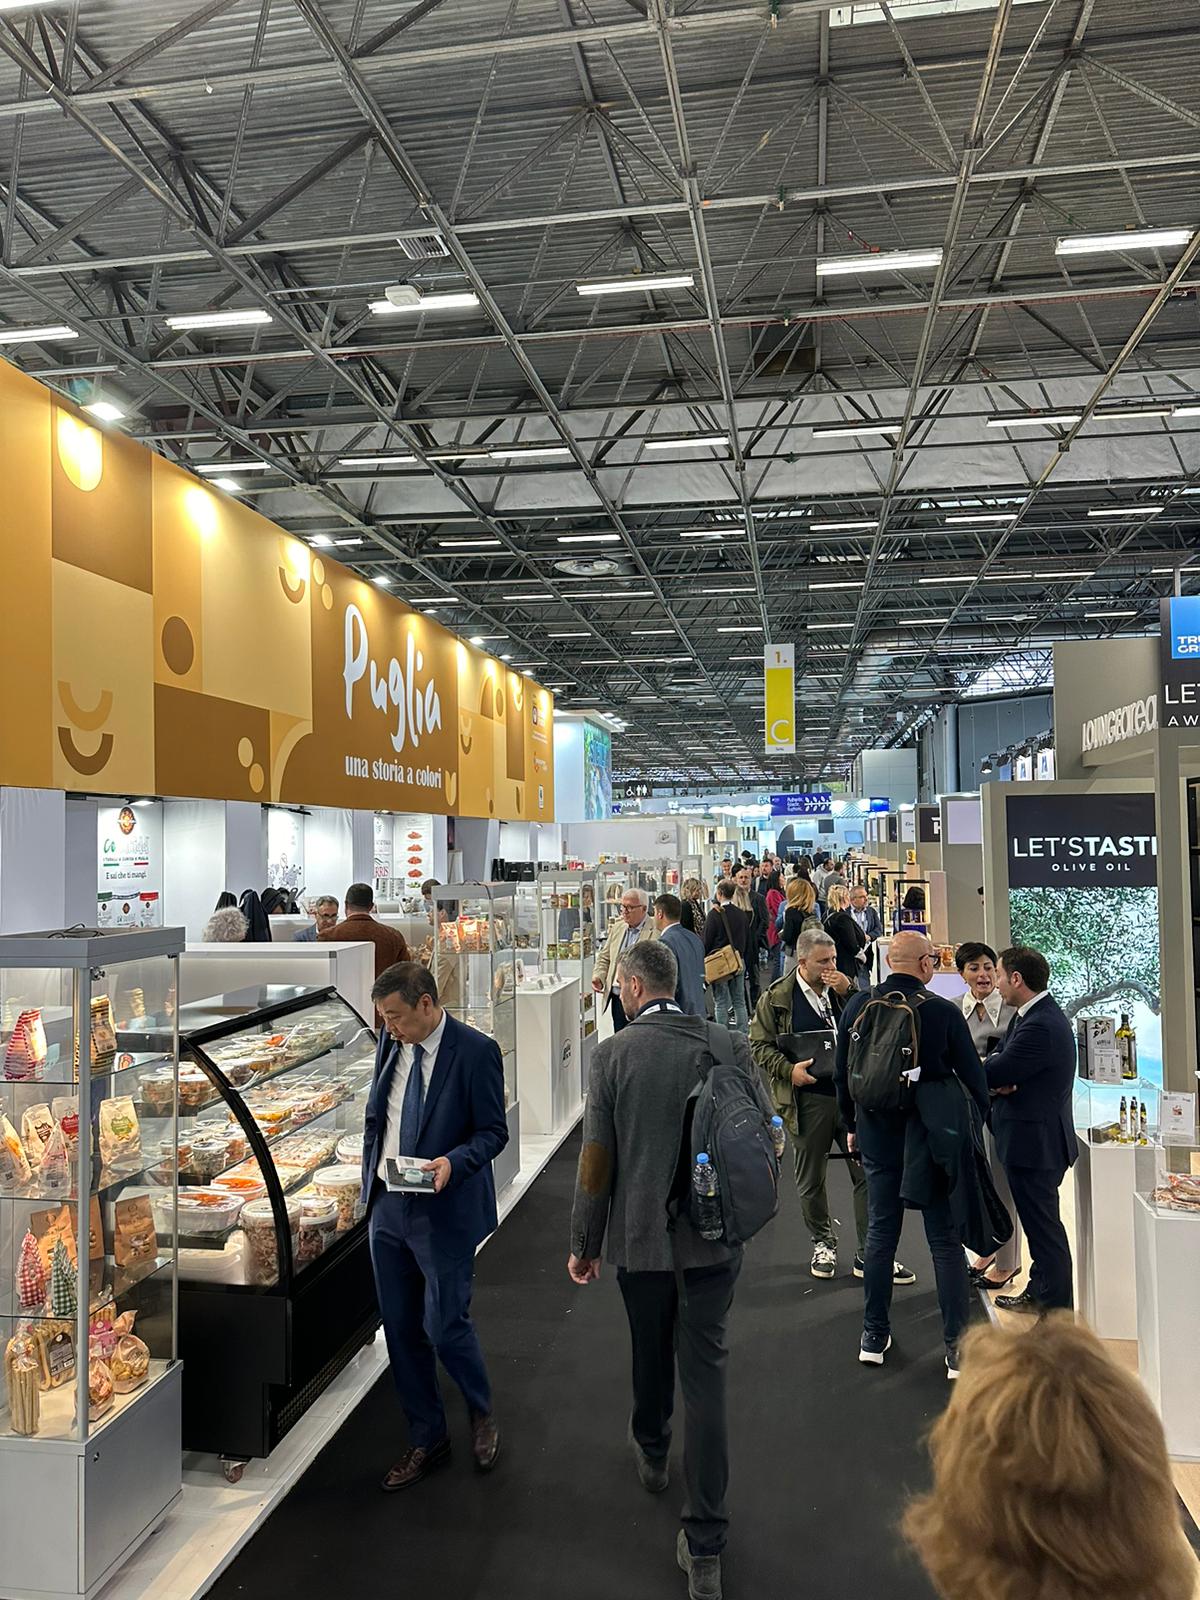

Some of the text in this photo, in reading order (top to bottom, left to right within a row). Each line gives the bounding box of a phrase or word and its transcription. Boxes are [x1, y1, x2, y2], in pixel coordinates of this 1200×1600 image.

[1177, 635, 1200, 645] TR
[1177, 644, 1200, 654] GR
[343, 603, 442, 753] Puglia
[770, 719, 790, 744] C
[345, 755, 442, 789] una storia a colori
[1051, 863, 1131, 872] OLIVE OIL
